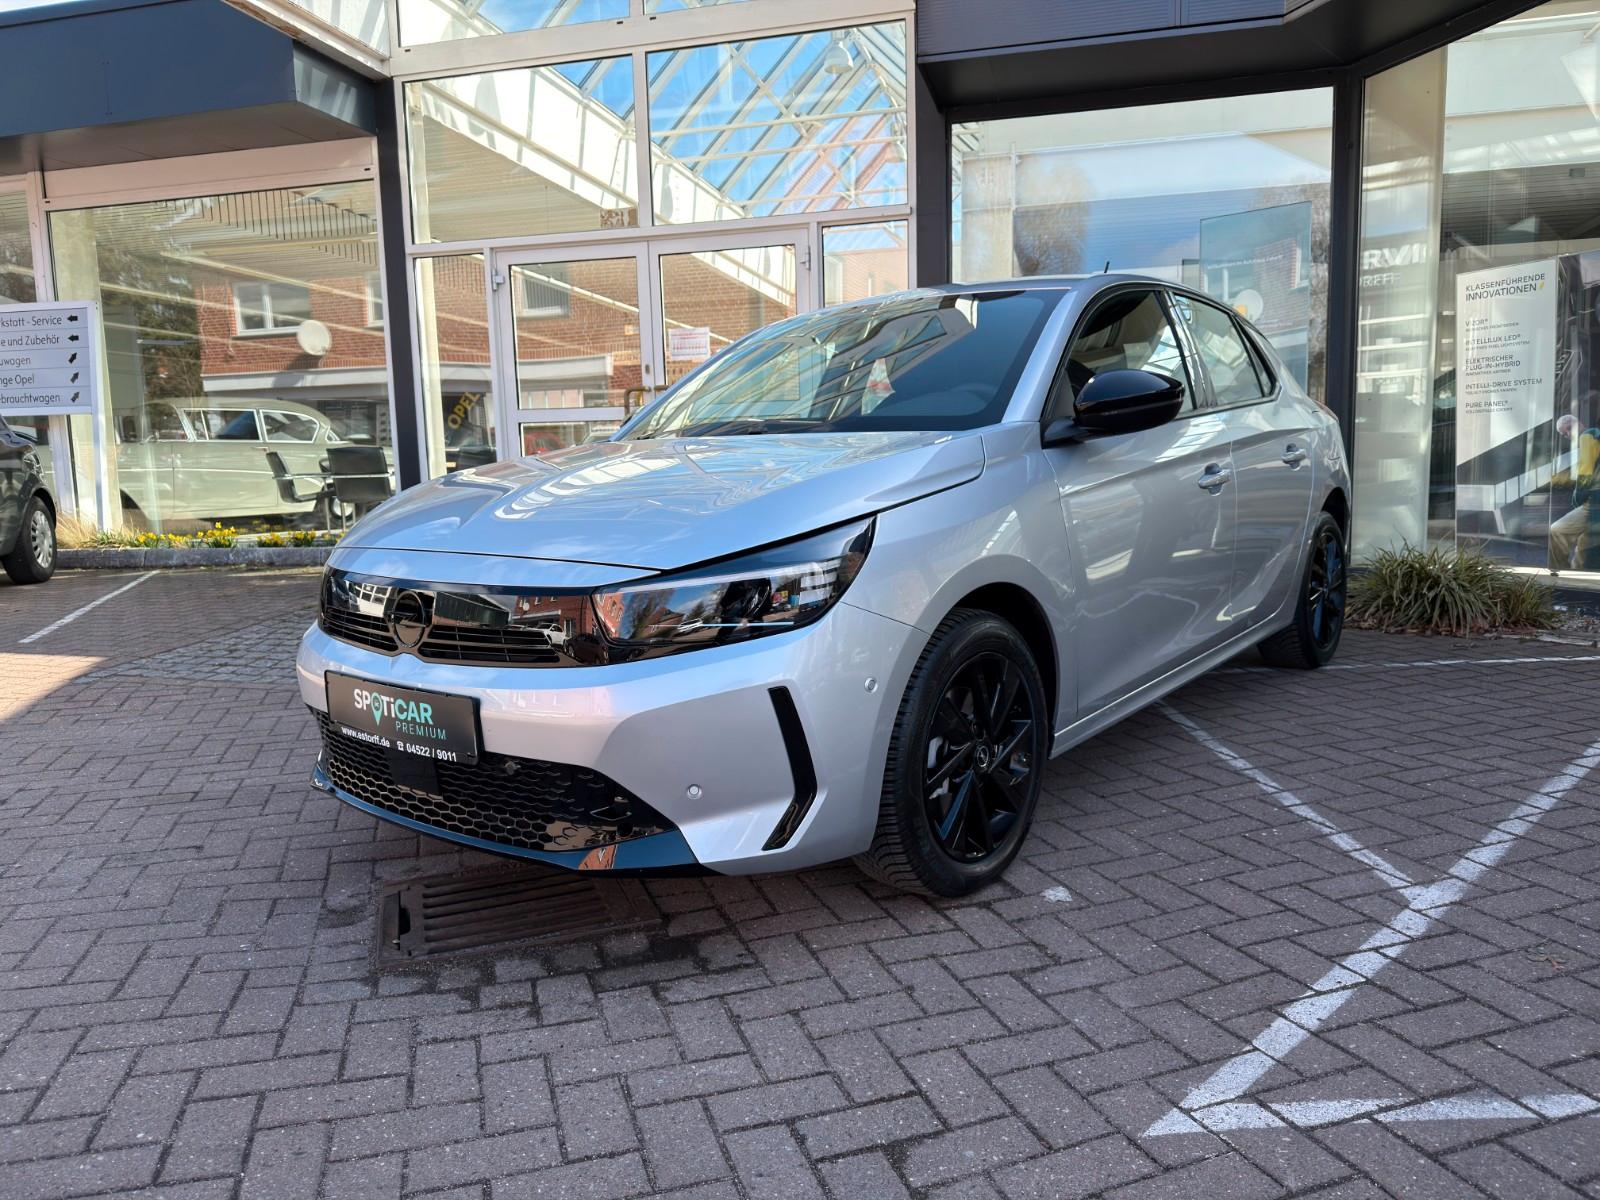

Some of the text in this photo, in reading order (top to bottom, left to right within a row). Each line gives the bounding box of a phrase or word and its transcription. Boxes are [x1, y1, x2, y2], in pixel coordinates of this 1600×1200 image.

[1465, 273, 1545, 292] KLASSENFÜHRENDE
[1465, 283, 1537, 302] INNOVATIONEN
[31, 316, 62, 326] Service
[7, 336, 23, 346] und
[25, 334, 60, 346] Zubehör
[1465, 354, 1514, 365] ELEKTRISCHER
[1465, 360, 1521, 371] PLUG-IN-HYBRID
[15, 373, 35, 387] Opel
[1465, 378, 1543, 390] INTELLI-DRIVE SYSTEM
[447, 391, 481, 430] OPEL
[395, 721, 448, 740] PREMIUM
[341, 726, 391, 748] www.estorff.de
[406, 743, 431, 757] 04522
[436, 749, 458, 762] 9011
